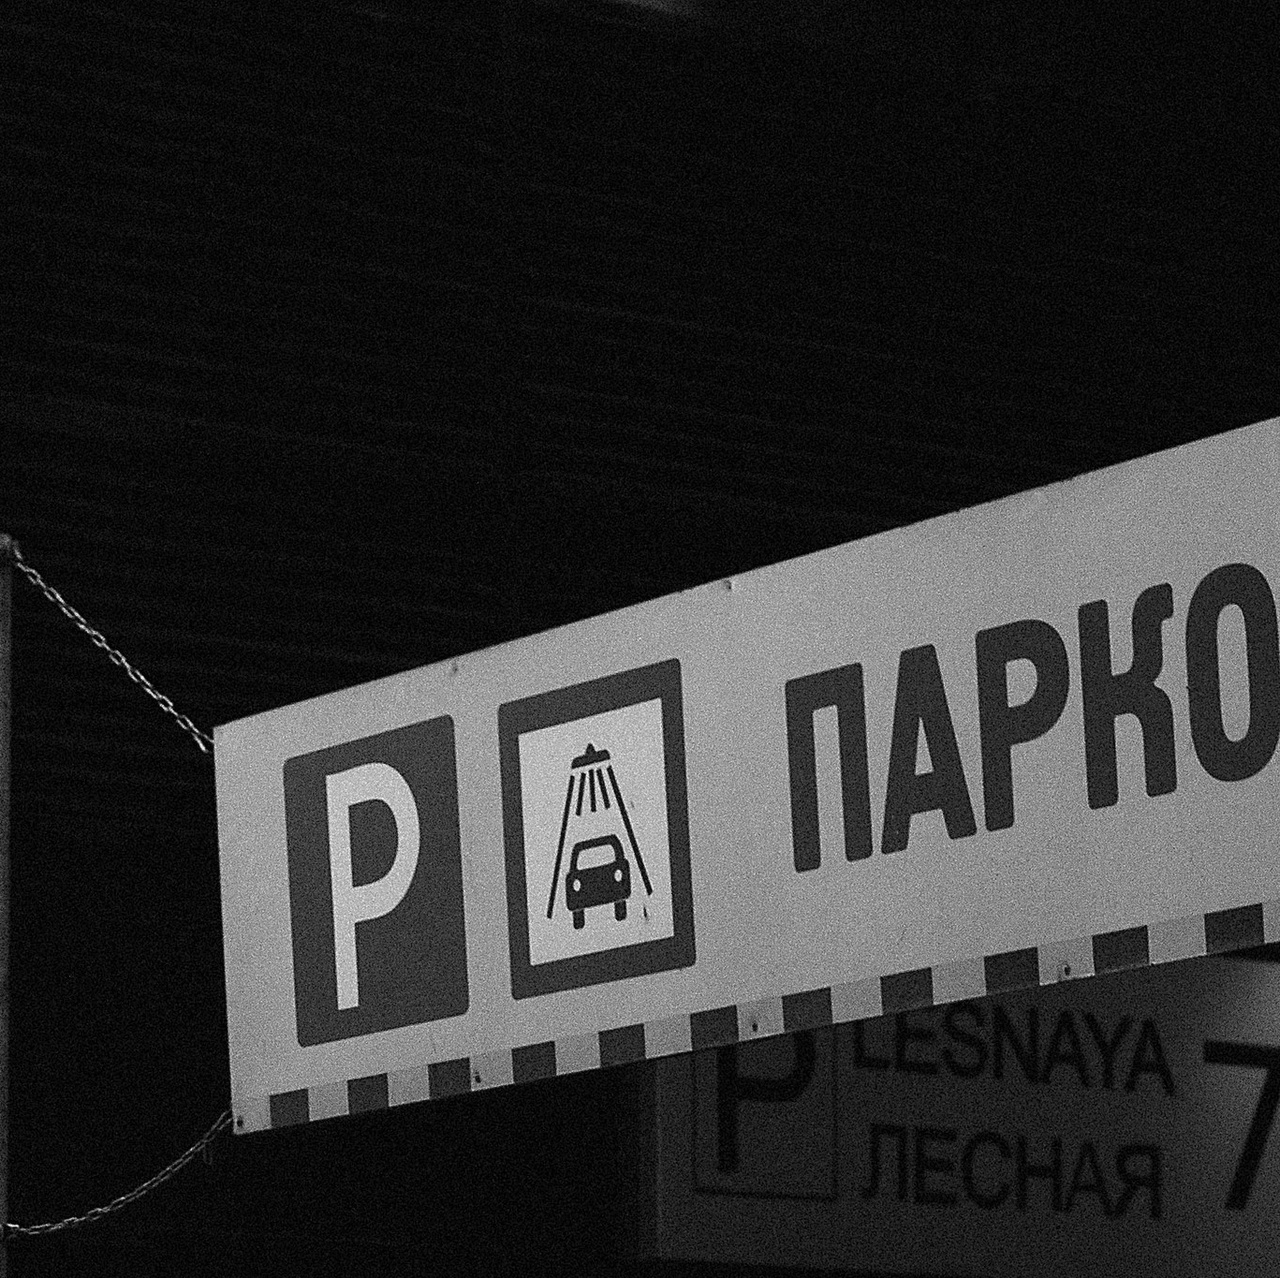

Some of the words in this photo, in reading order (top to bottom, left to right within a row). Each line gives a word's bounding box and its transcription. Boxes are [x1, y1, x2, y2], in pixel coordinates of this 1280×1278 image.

[785, 563, 1280, 874] ПАРКО
[326, 760, 422, 1012] P
[852, 1001, 1176, 1096] LESNAYA
[1203, 1039, 1280, 1211] 7
[863, 1124, 1163, 1220] ЛЕСНАЯ
